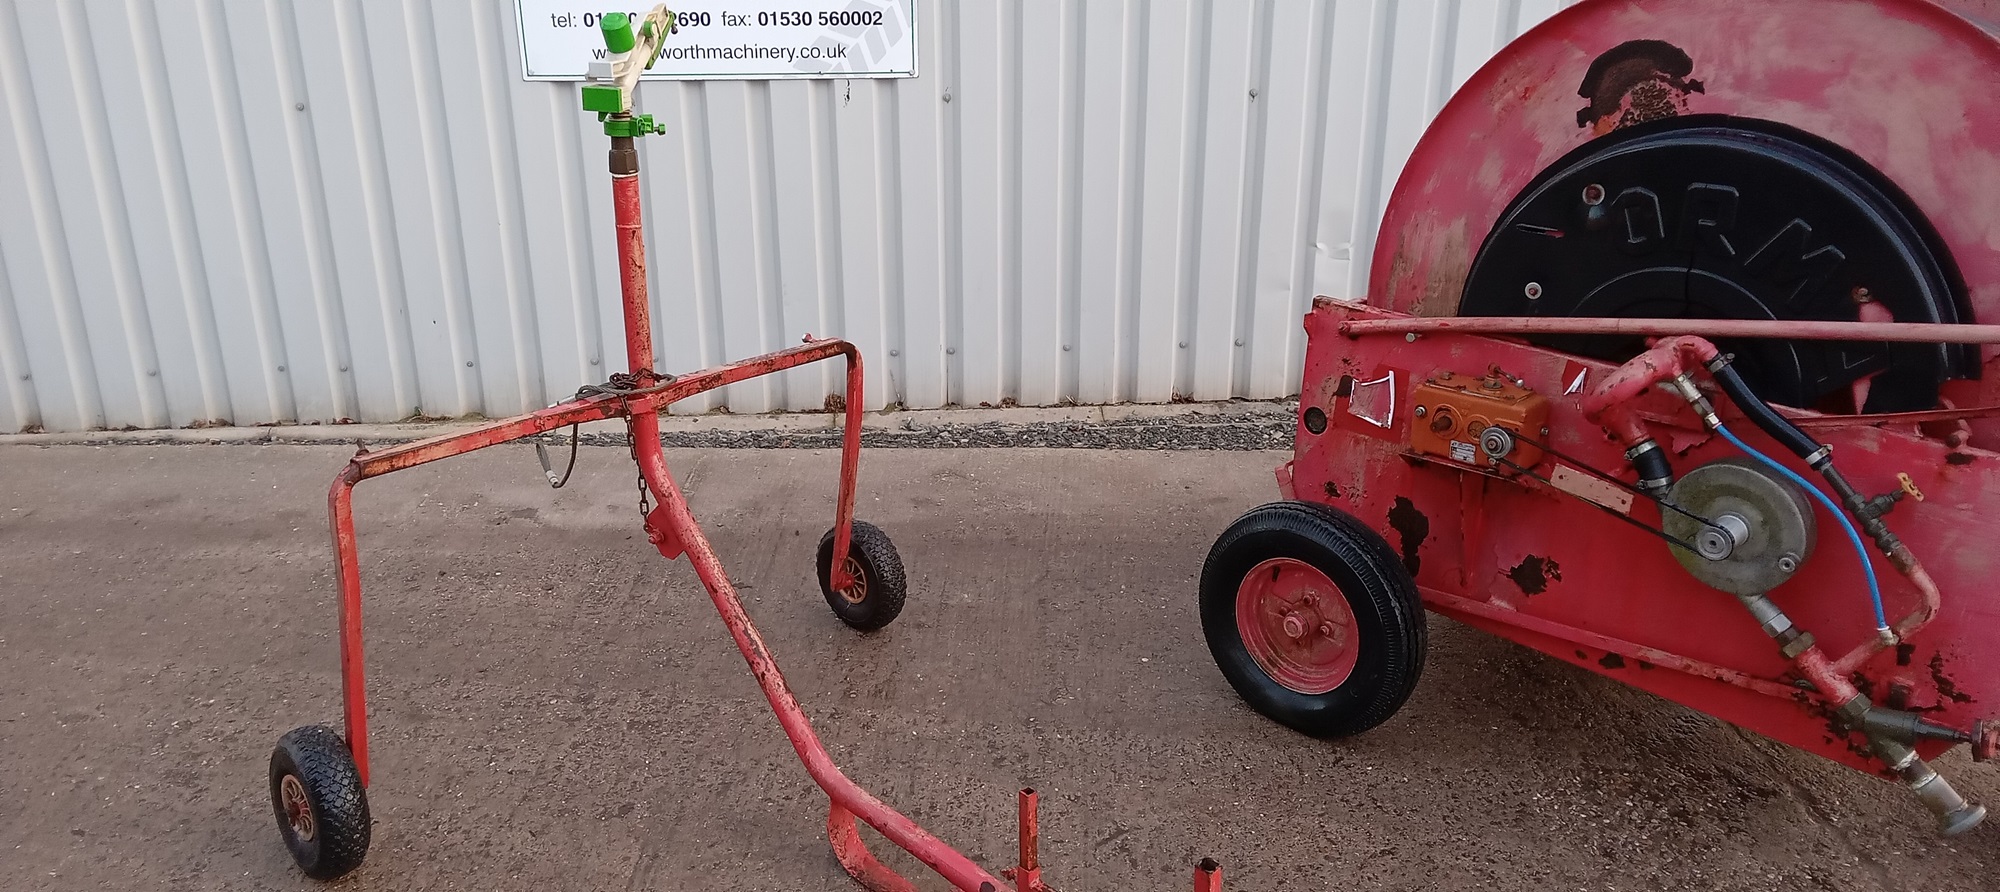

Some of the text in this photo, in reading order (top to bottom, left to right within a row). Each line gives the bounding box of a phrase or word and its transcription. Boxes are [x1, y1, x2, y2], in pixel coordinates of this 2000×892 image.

[551, 12, 578, 28] tel:
[721, 11, 752, 27] fax:
[758, 11, 813, 27] 01530
[818, 11, 883, 27] 560002
